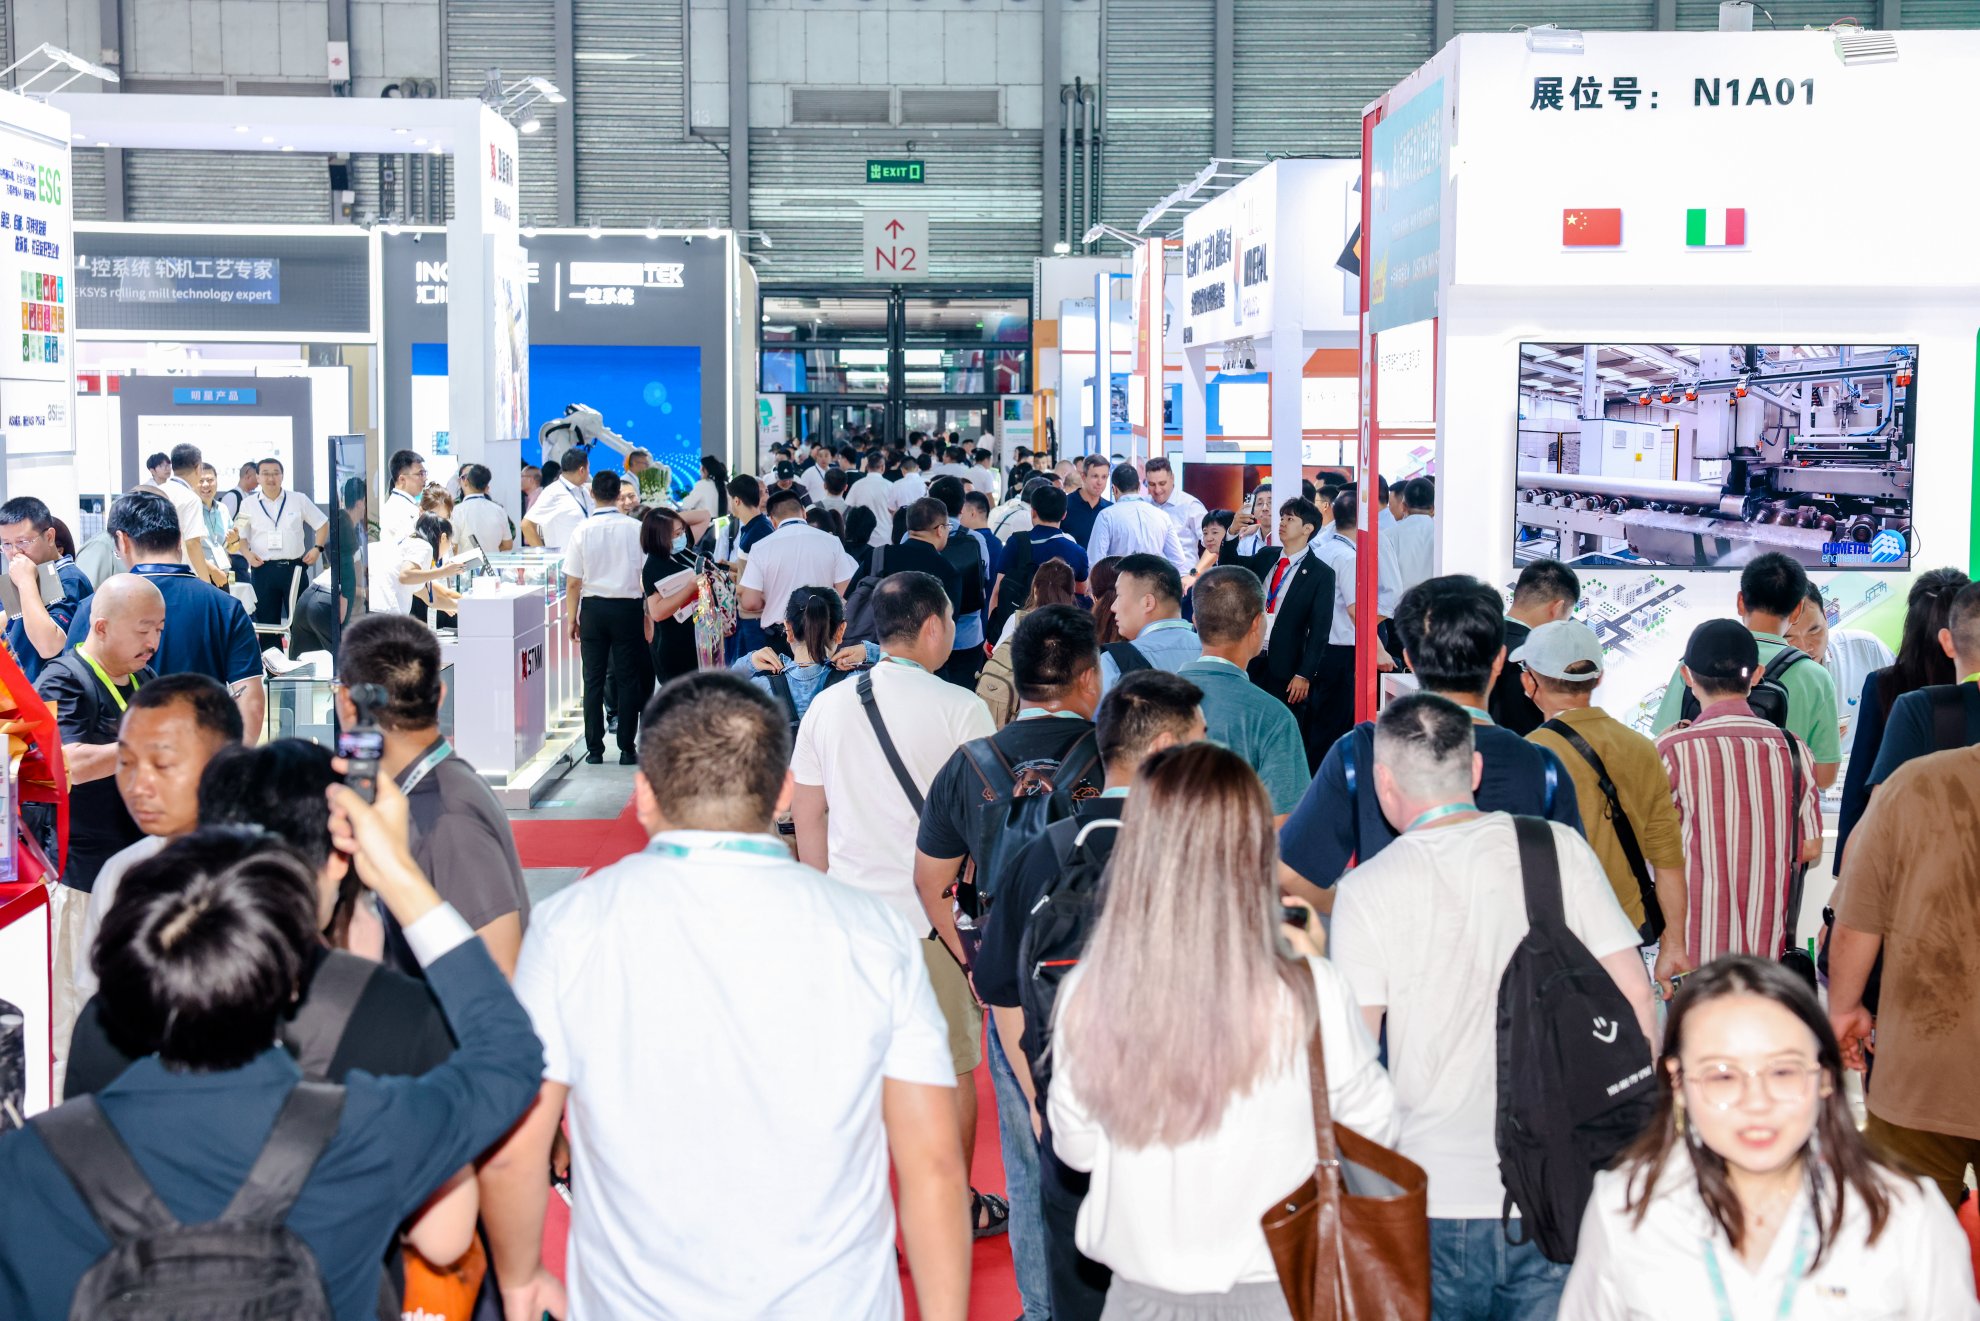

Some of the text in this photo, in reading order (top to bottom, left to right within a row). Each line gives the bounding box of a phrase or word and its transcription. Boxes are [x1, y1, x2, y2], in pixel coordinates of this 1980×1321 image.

[1694, 77, 1814, 107] N1A01
[882, 166, 907, 177] EXIT
[38, 165, 61, 205] ESG
[876, 247, 916, 271] N2
[155, 258, 272, 280] 轧机工艺专家
[110, 287, 146, 301] rolling
[149, 287, 170, 299] mill
[172, 287, 234, 302] technology
[236, 289, 272, 302] expert
[190, 390, 239, 402] 明星产品
[1822, 542, 1870, 554] COMETAL
